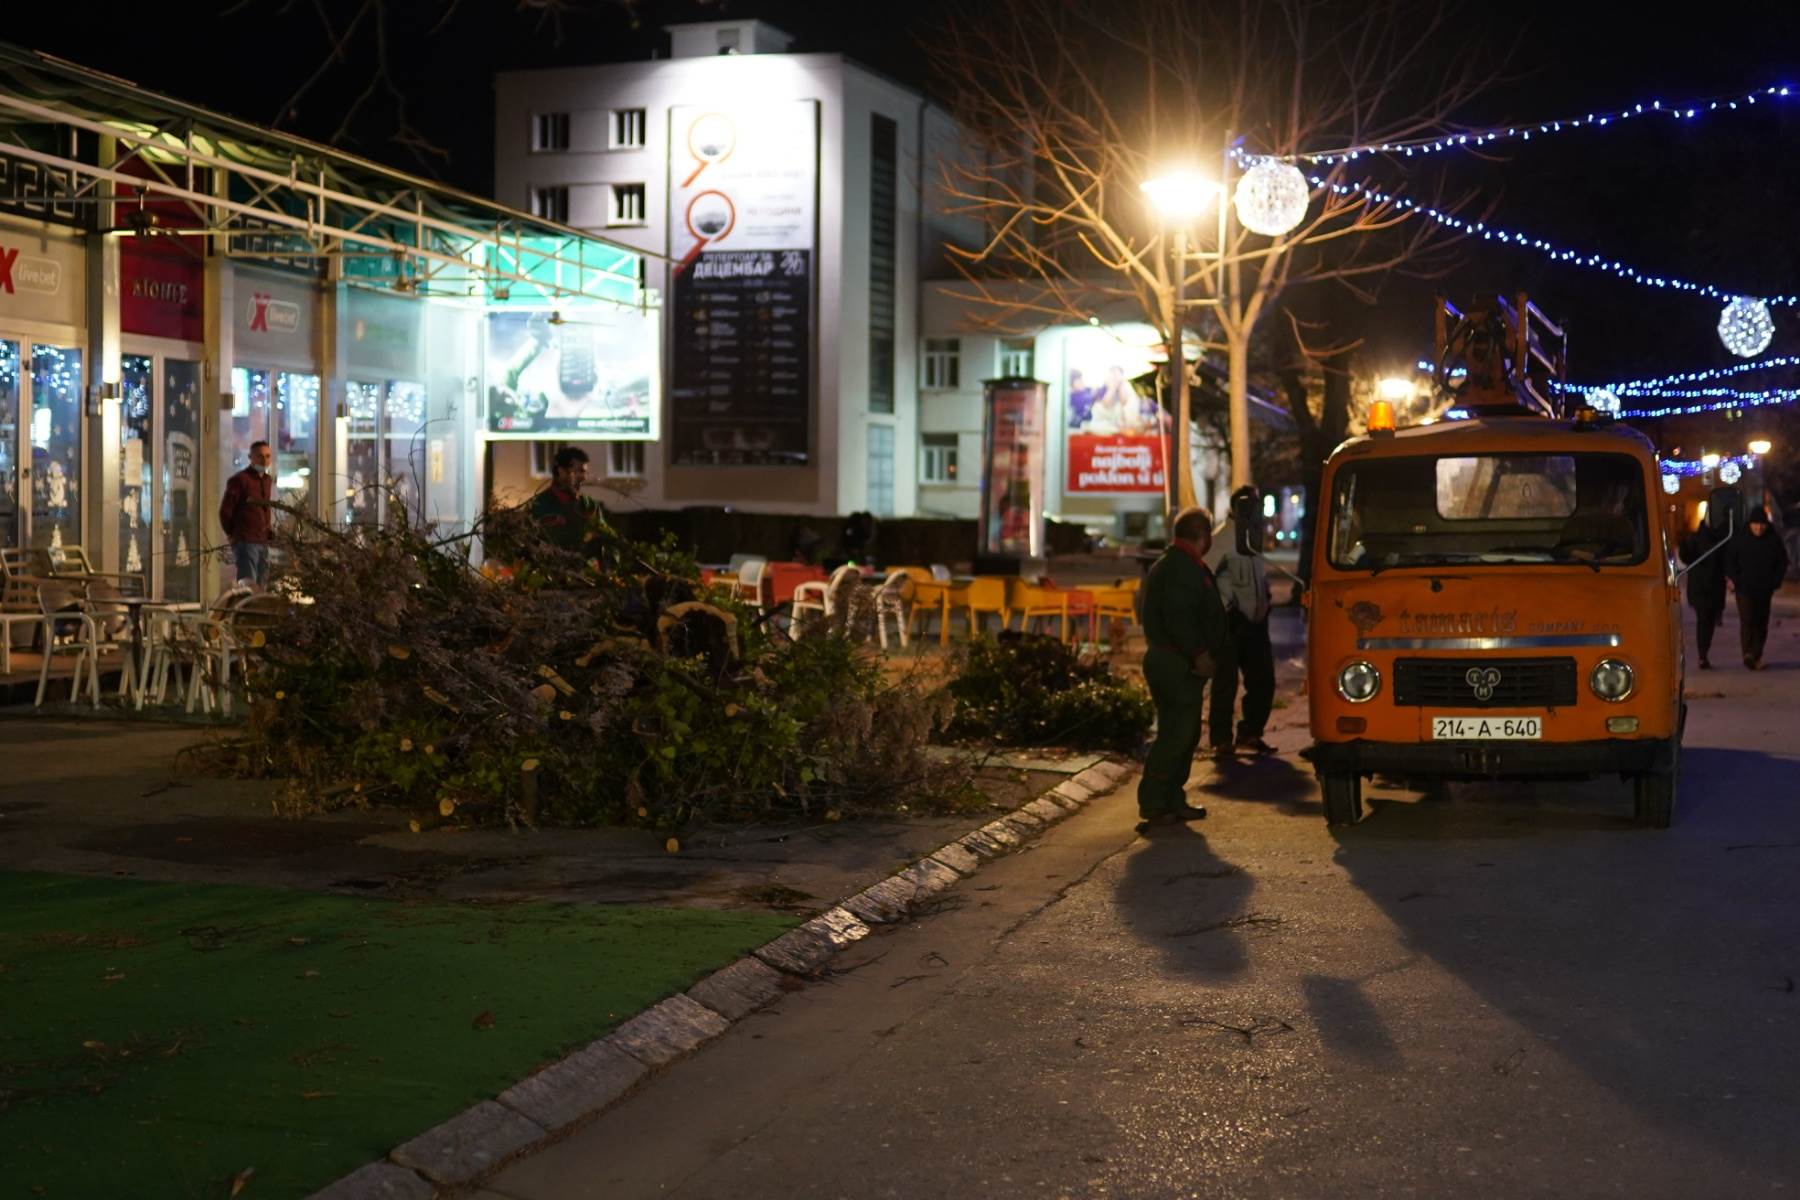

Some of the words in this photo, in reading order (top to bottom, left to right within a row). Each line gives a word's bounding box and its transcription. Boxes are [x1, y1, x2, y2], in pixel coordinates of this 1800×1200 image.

[692, 260, 775, 279] ДЕЦЕМБАР
[1400, 607, 1518, 633] tamaris
[1437, 719, 1537, 737] 214-A-640
